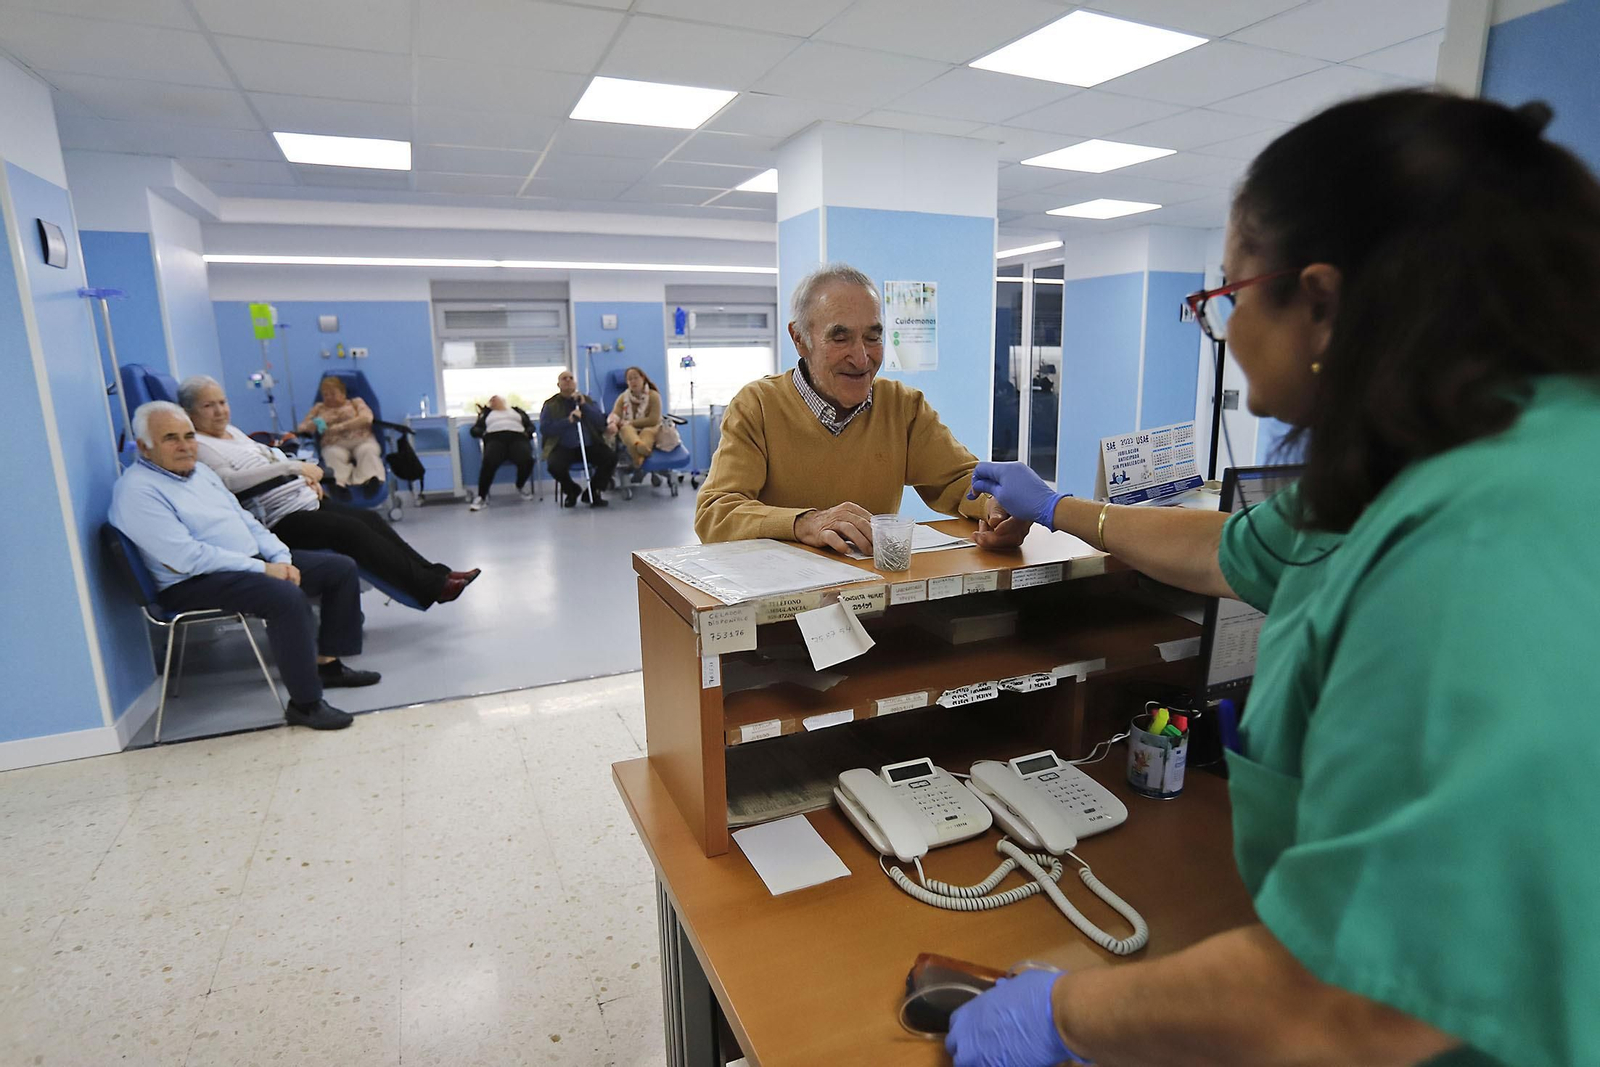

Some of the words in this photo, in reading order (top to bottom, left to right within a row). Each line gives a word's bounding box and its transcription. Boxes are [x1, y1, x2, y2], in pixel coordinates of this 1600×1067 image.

[1106, 441, 1116, 451] SAE
[1120, 437, 1133, 446] 2023
[1135, 434, 1149, 445] USAE
